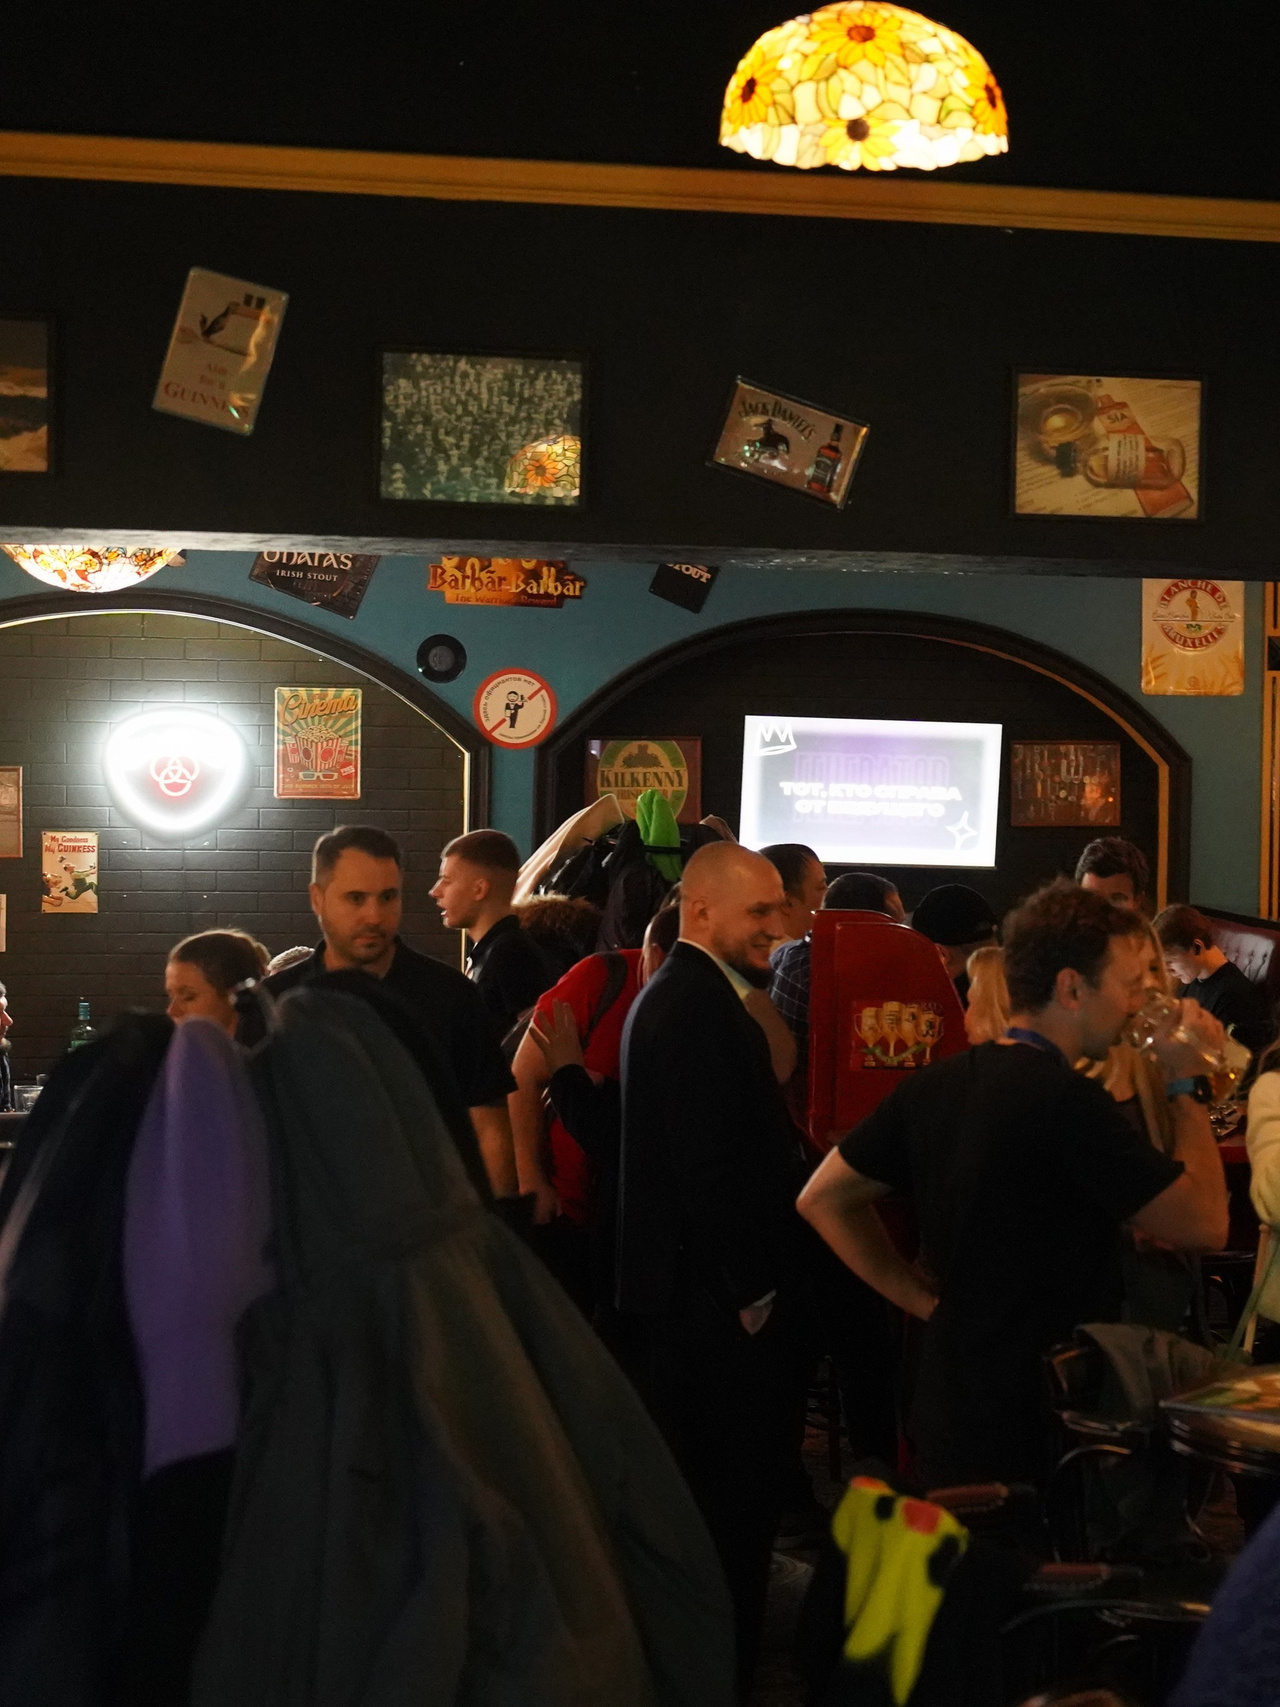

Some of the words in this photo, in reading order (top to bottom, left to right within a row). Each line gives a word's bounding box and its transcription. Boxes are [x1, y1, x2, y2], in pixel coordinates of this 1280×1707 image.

[163, 381, 251, 418] GUINNES
[276, 569, 304, 579] IRISH
[307, 573, 339, 582] STOUT
[667, 564, 712, 584] OUT
[280, 693, 358, 726] Cinema
[600, 769, 686, 788] KILKENNY
[57, 843, 96, 853] GUINNESS
